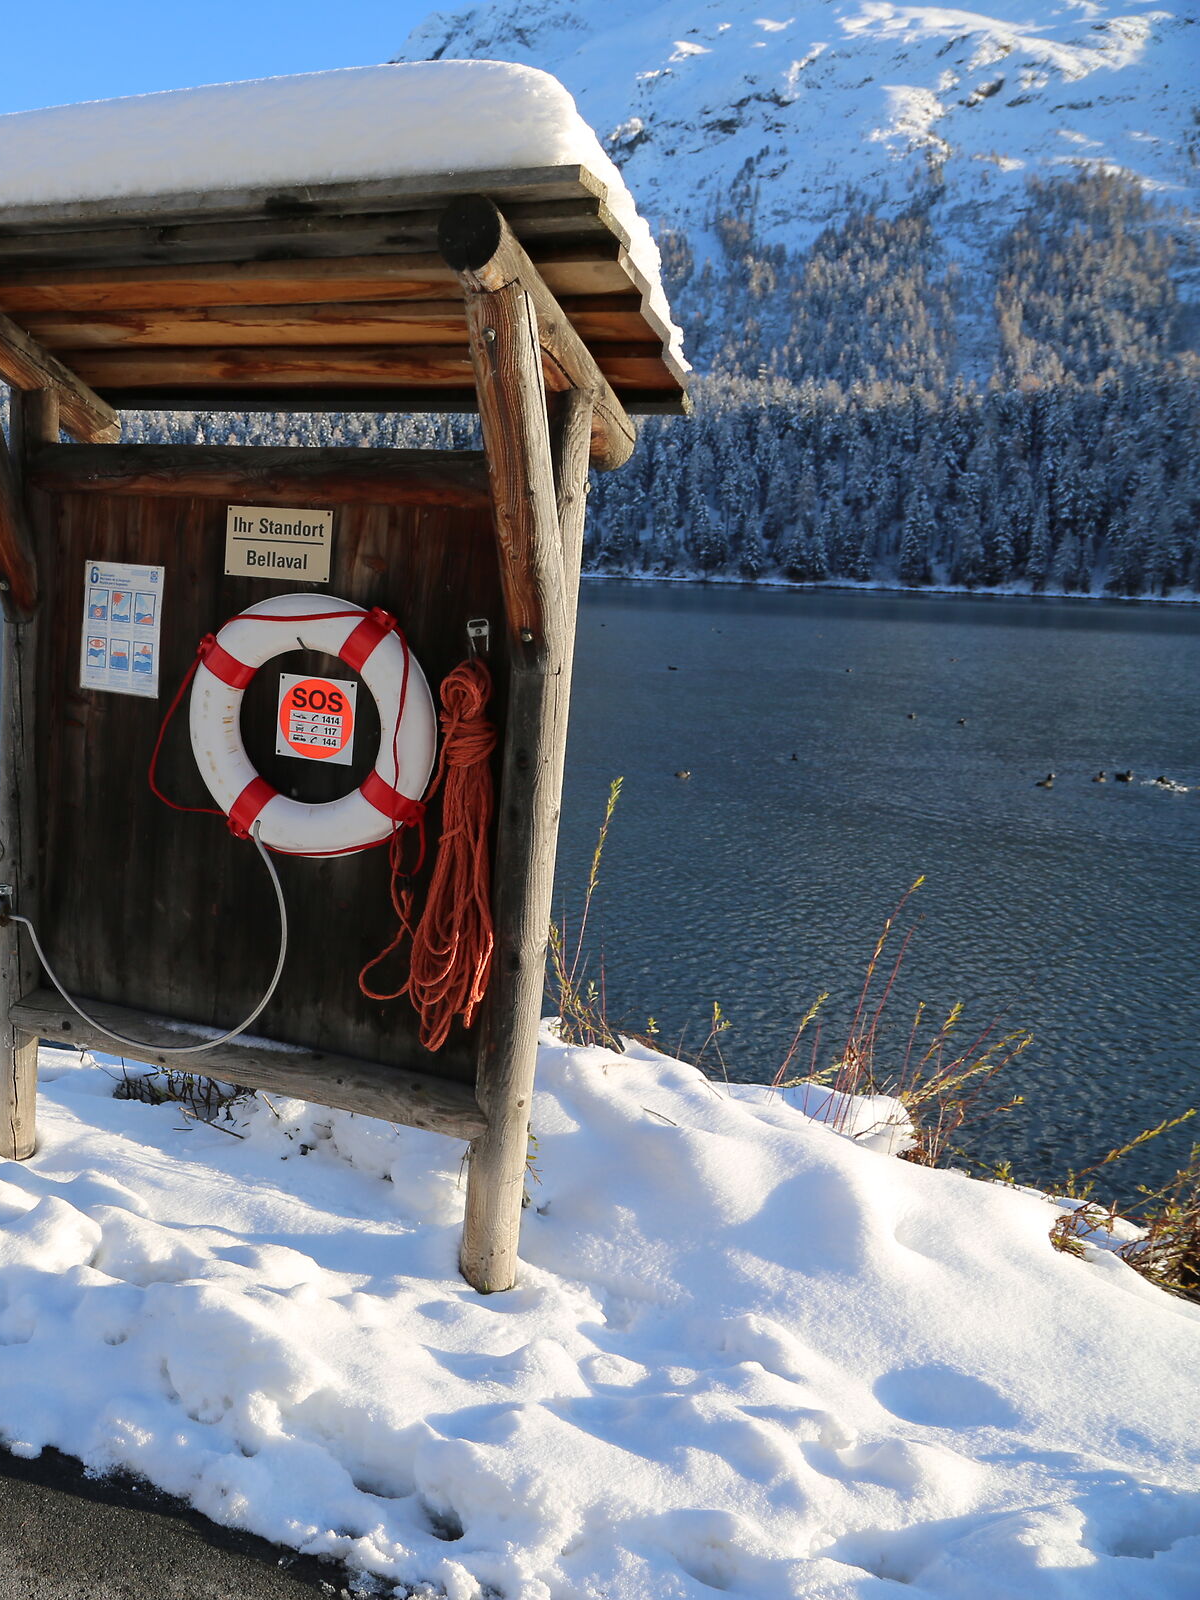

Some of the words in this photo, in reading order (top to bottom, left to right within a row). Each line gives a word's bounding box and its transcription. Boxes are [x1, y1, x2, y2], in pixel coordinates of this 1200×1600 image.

[233, 516, 254, 533] Ihr
[259, 518, 324, 537] Standort
[246, 550, 308, 569] Bellaval
[90, 566, 99, 583] 6
[292, 687, 343, 712] SOS
[321, 715, 340, 725] 1414
[324, 727, 337, 736] 117
[322, 738, 337, 747] 144
